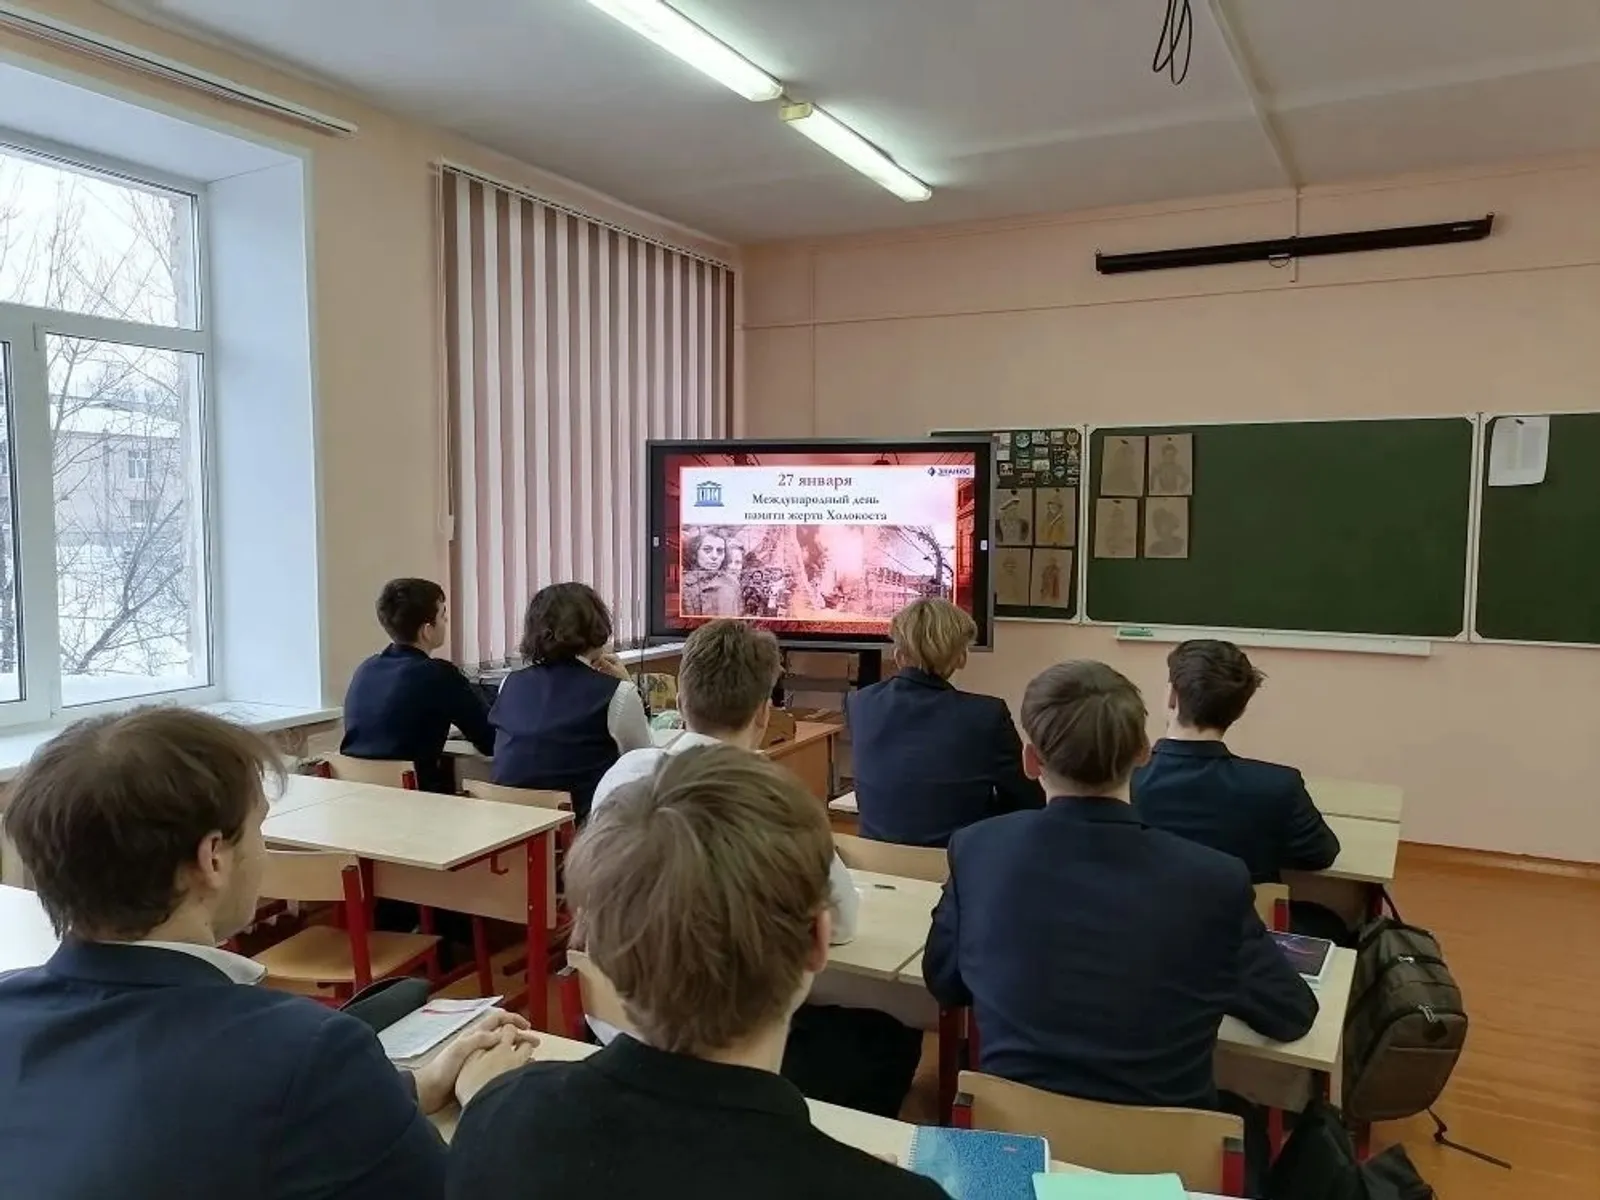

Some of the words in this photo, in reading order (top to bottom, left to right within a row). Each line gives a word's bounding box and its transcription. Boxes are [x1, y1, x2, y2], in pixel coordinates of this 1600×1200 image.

[778, 473, 794, 487] 27
[798, 476, 853, 490] января
[752, 493, 850, 507] Международный
[852, 495, 880, 506] день
[744, 511, 785, 521] памяти
[826, 509, 888, 521] Холокоста
